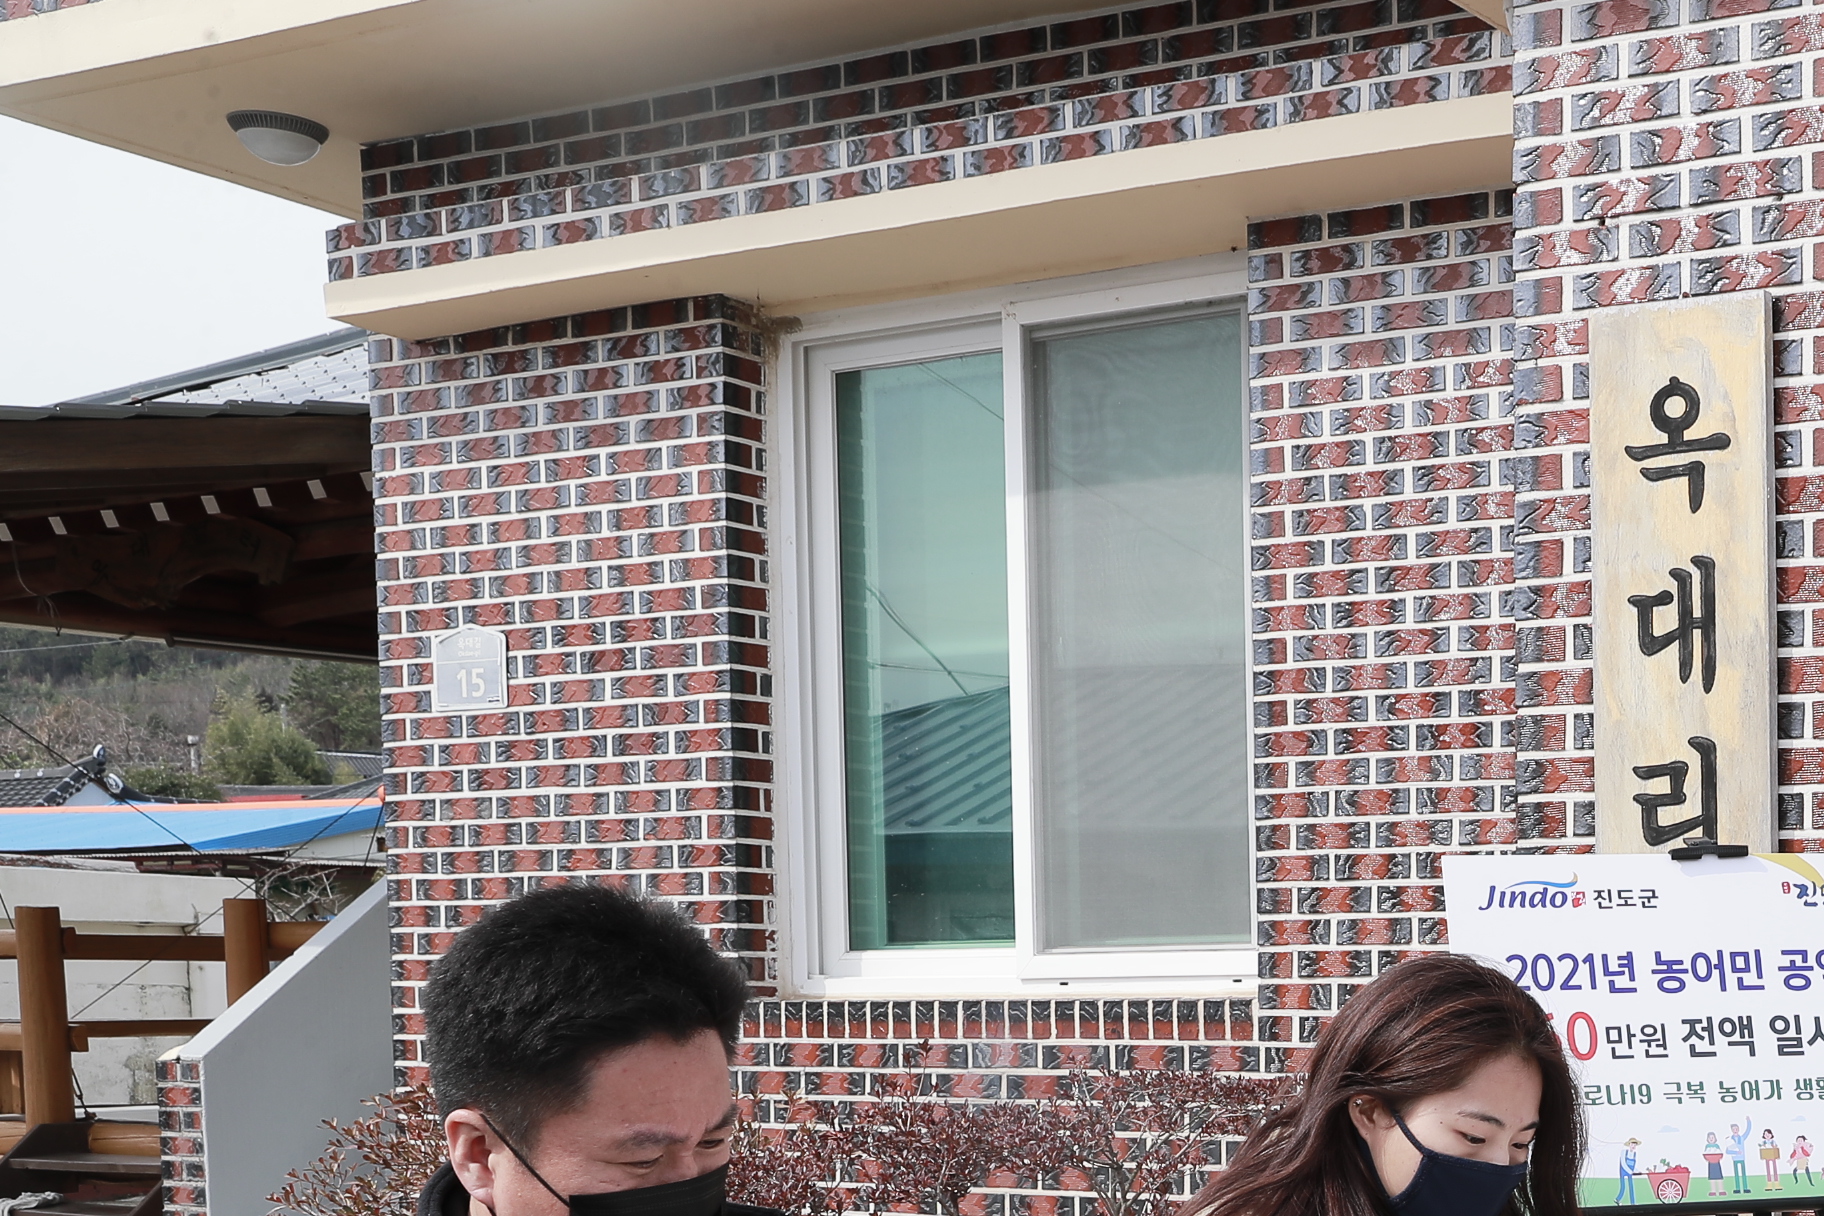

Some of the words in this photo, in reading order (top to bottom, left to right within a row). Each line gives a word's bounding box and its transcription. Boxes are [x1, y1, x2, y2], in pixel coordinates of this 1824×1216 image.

[456, 668, 486, 698] 15
[1478, 885, 1569, 911] Jindo
[1593, 889, 1659, 910] 진도군
[1505, 951, 1637, 994] 2021년
[1651, 948, 1766, 994] 농어민
[1681, 1014, 1757, 1058] 전액
[1663, 1080, 1707, 1104] 극복
[1717, 1077, 1783, 1103] 농어가
